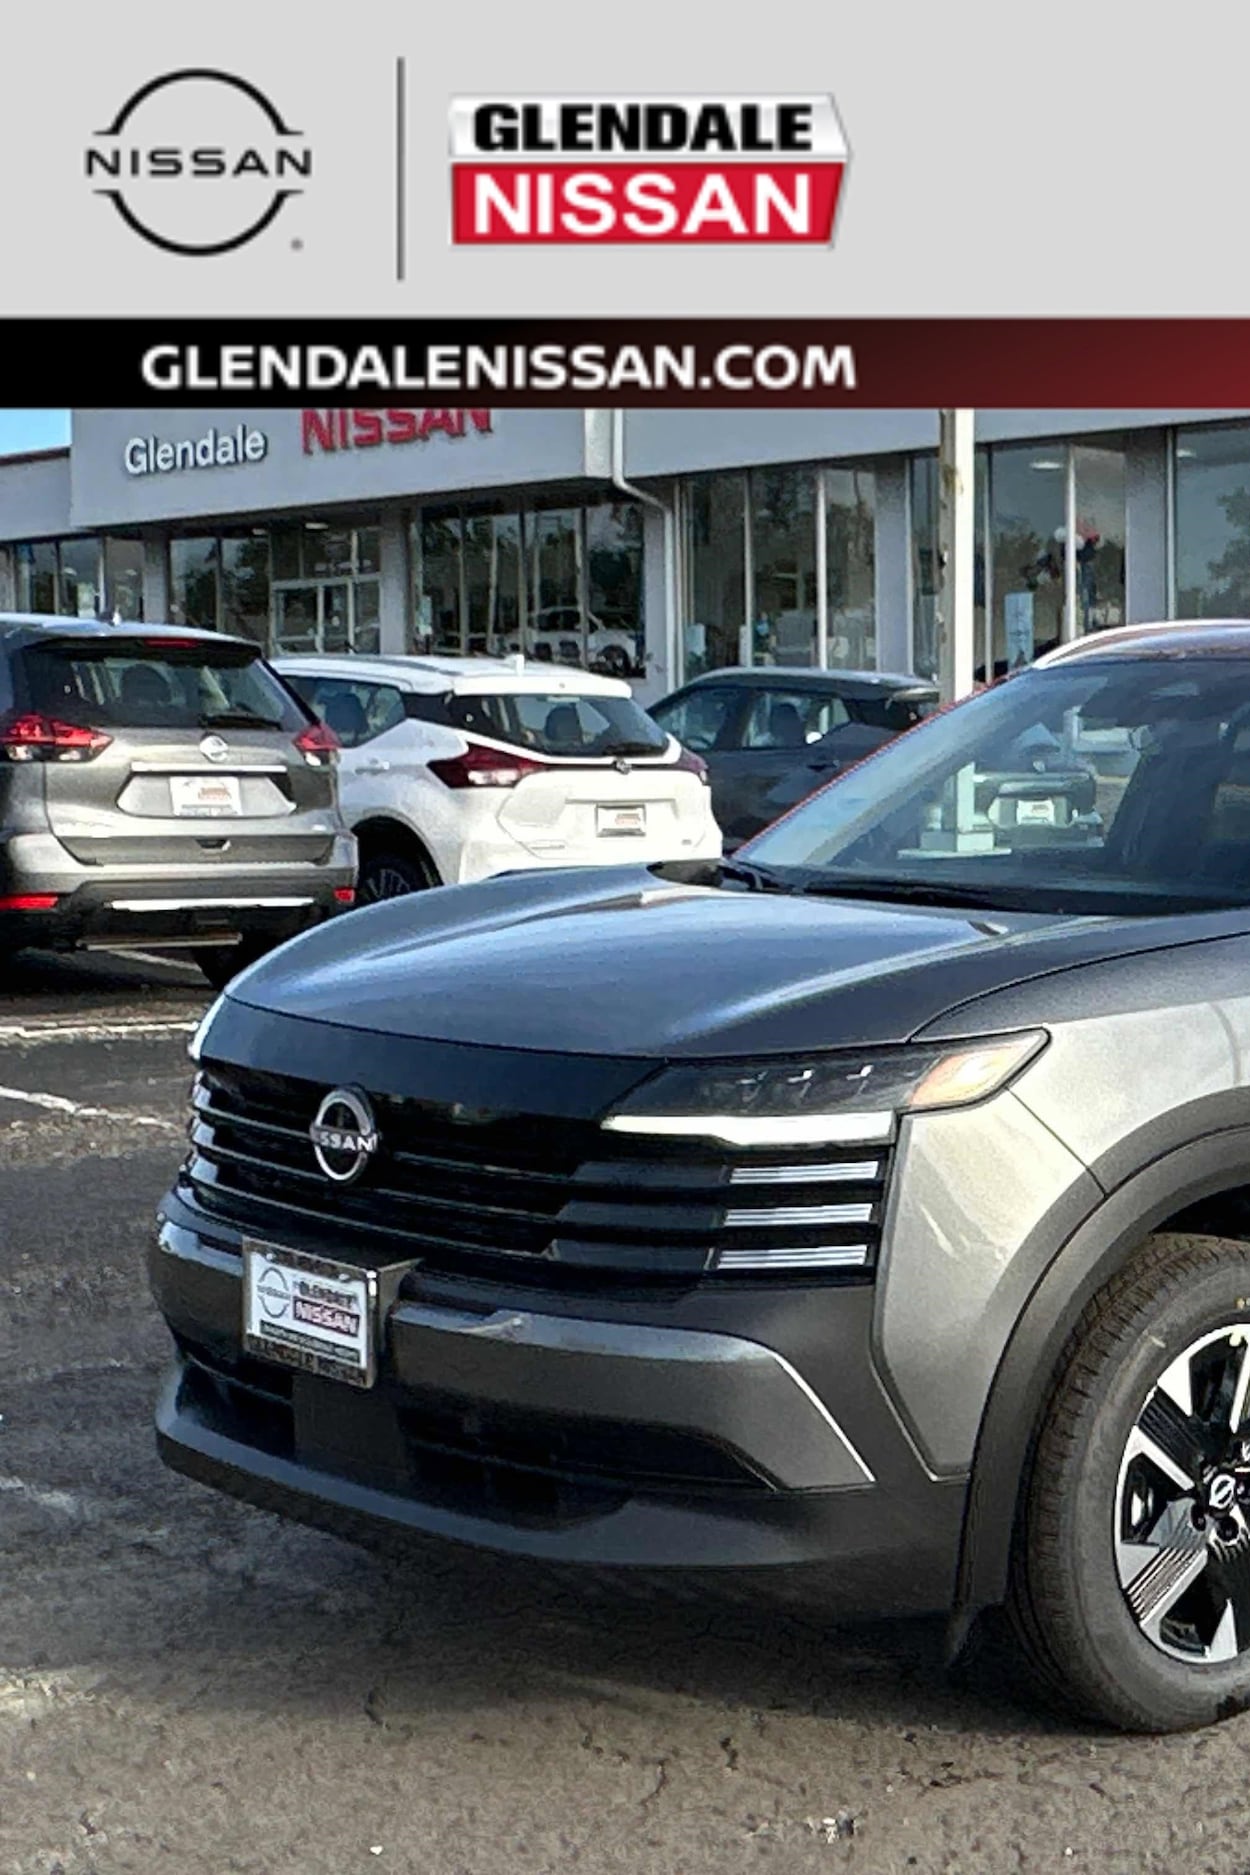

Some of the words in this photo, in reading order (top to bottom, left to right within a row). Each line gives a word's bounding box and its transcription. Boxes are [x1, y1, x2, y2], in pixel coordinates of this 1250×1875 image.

[124, 424, 267, 476] Glendale
[301, 409, 493, 456] NISSAN
[314, 1130, 378, 1153] SSAN
[294, 1300, 360, 1336] NISSAN
